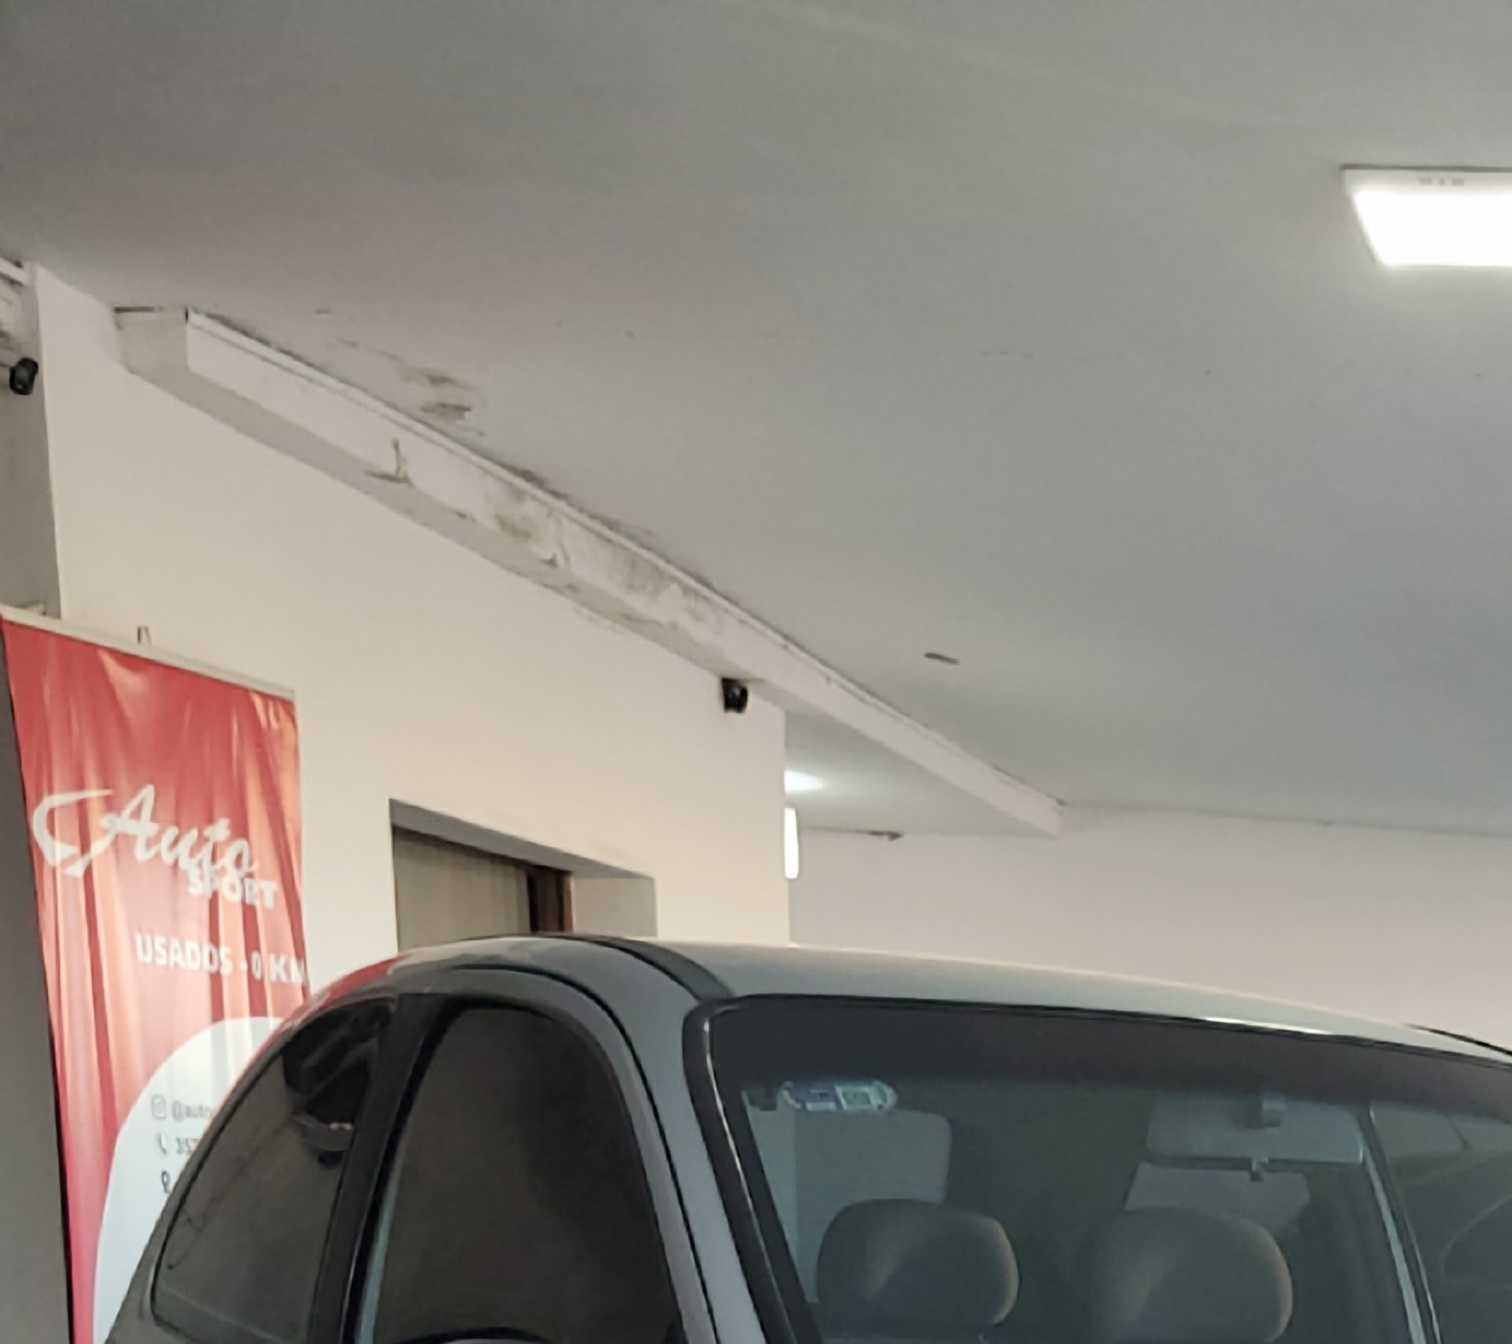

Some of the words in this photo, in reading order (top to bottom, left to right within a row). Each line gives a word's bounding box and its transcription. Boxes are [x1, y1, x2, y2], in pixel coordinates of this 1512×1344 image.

[62, 784, 258, 879] Auto
[188, 864, 278, 909] SPORT
[135, 933, 234, 976] USADOS
